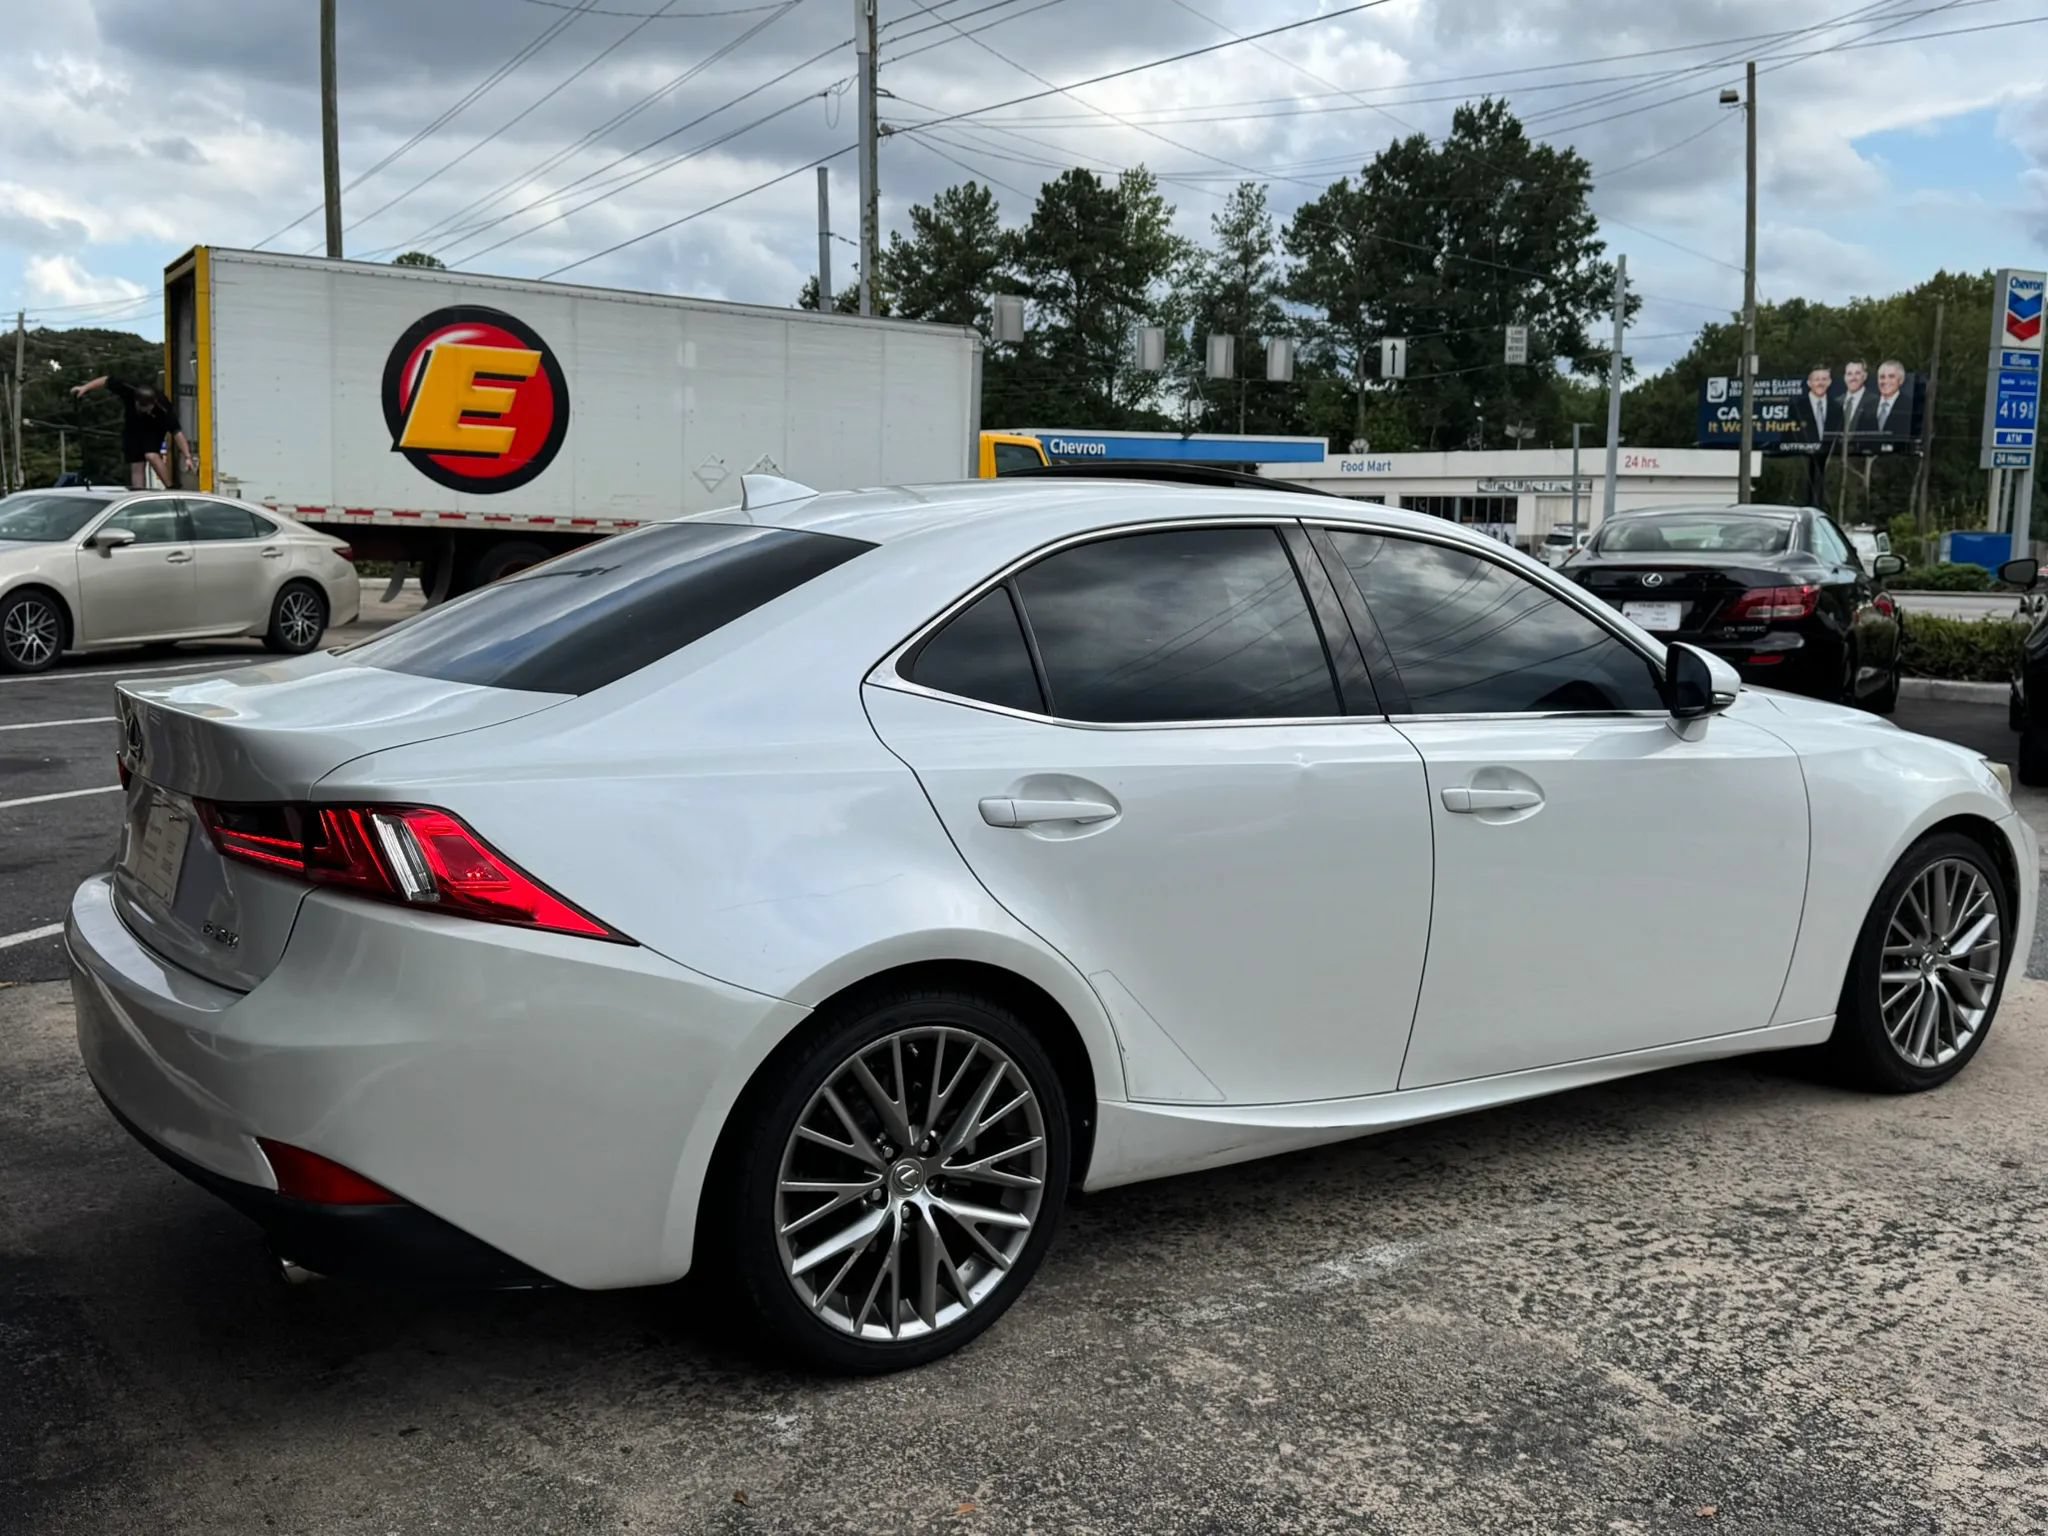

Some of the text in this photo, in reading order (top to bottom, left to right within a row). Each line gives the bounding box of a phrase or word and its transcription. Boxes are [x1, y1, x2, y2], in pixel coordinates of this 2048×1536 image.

[2010, 276, 2044, 290] Chevron
[391, 342, 543, 459] E
[1717, 405, 1789, 420] CA US!
[1708, 422, 1717, 432] It
[1722, 421, 1762, 432] Wo't
[2005, 433, 2023, 443] ATM
[1050, 439, 1106, 455] Chevron
[1341, 460, 1391, 472] Food Mart
[1625, 455, 1660, 468] 24 hrs.
